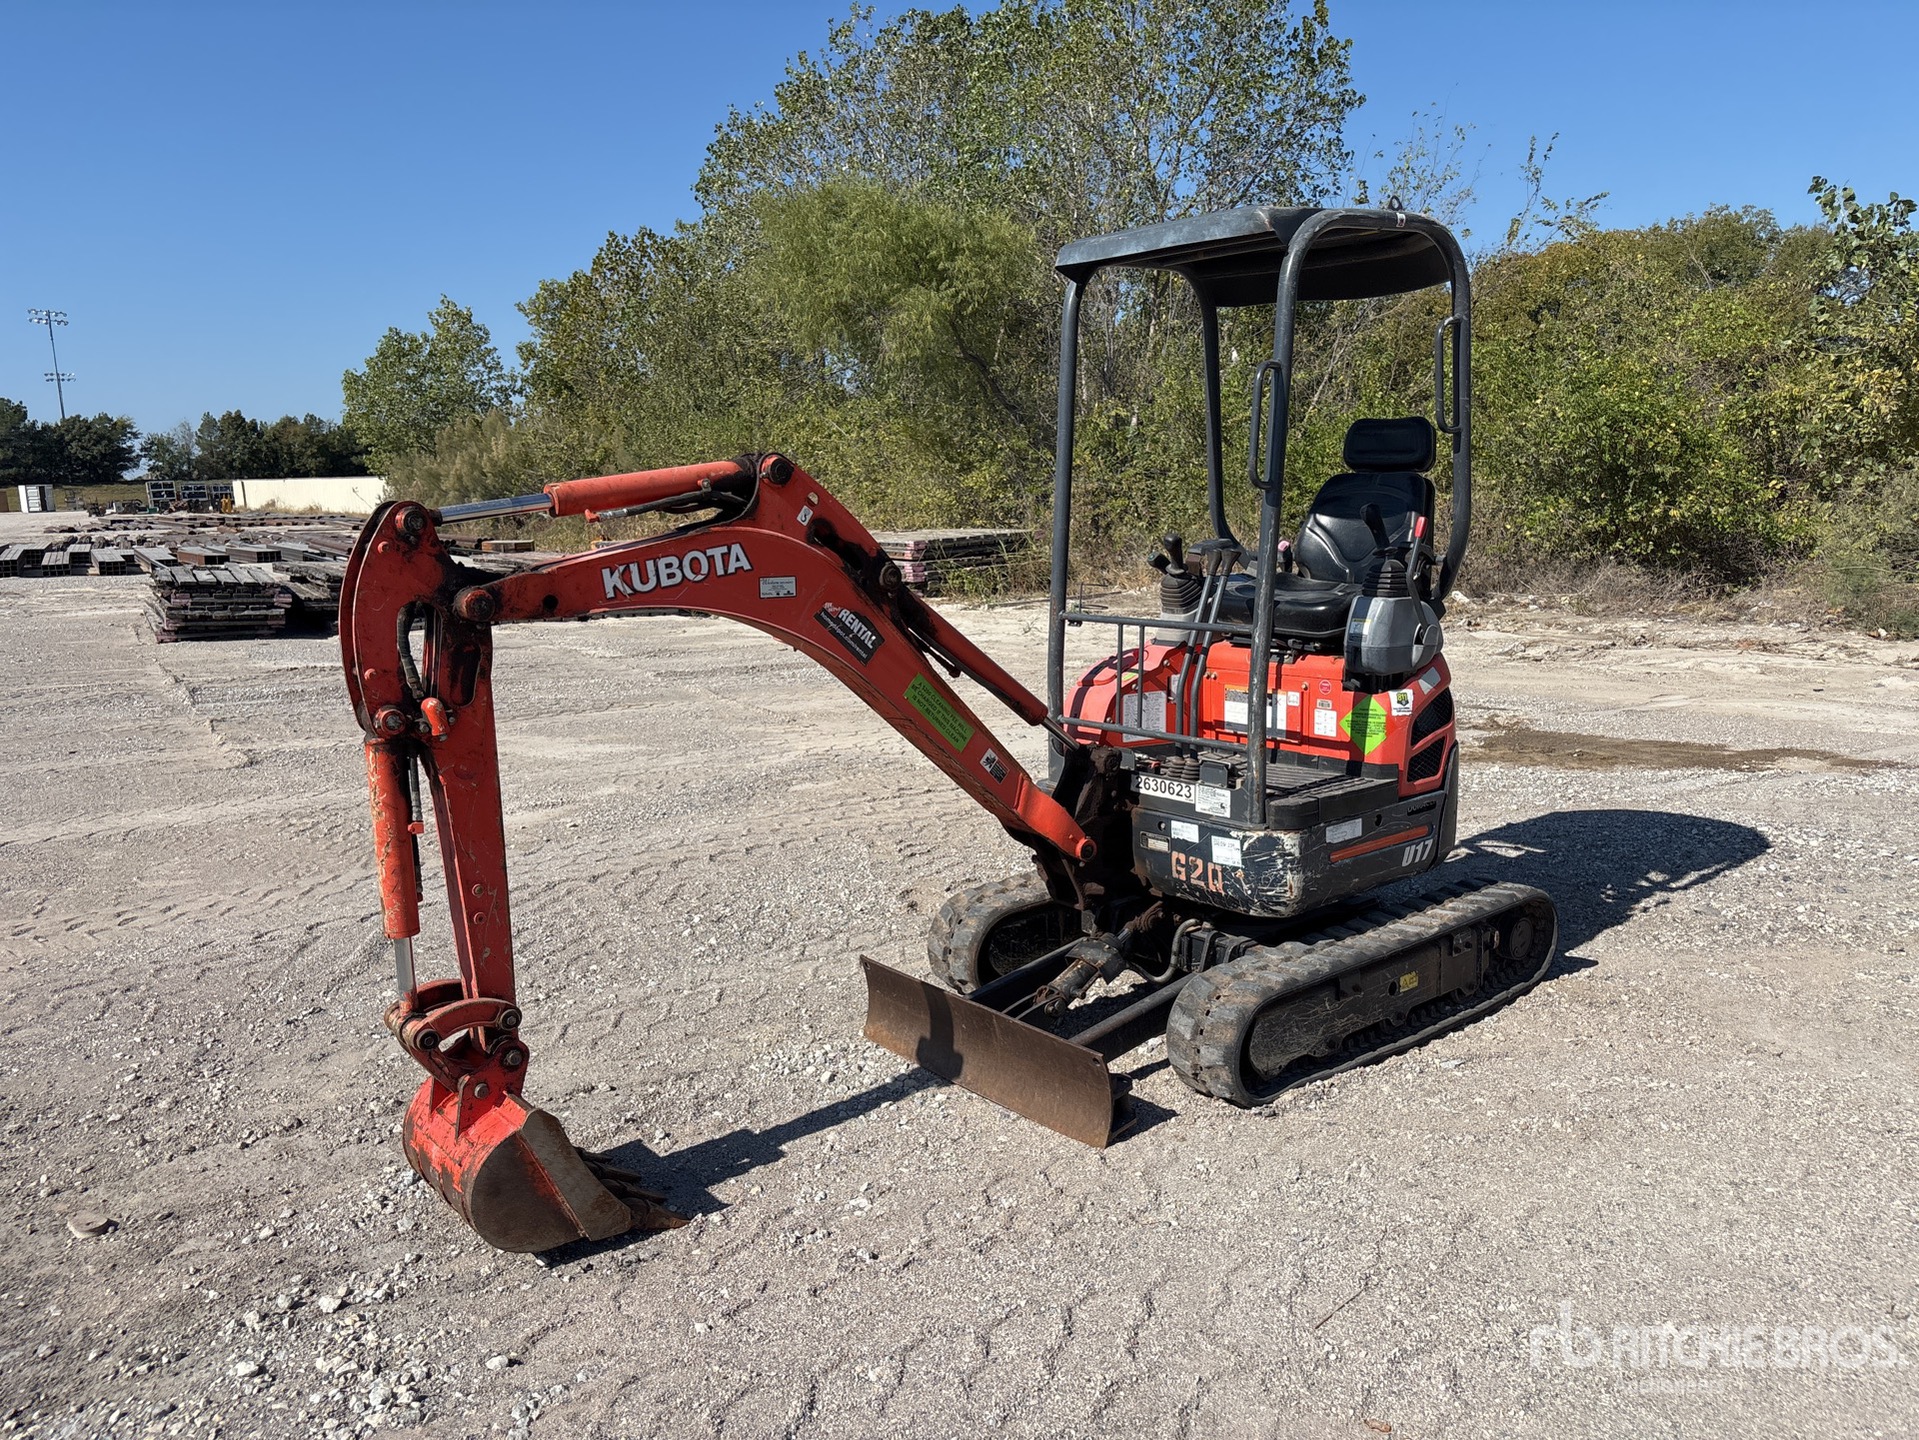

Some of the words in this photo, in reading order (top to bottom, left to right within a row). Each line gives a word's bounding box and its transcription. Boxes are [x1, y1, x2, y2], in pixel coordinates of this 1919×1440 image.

[601, 543, 752, 599] KUBOTA
[838, 608, 876, 649] RENTAL
[1135, 776, 1192, 799] 2630623
[1401, 839, 1434, 867] U17
